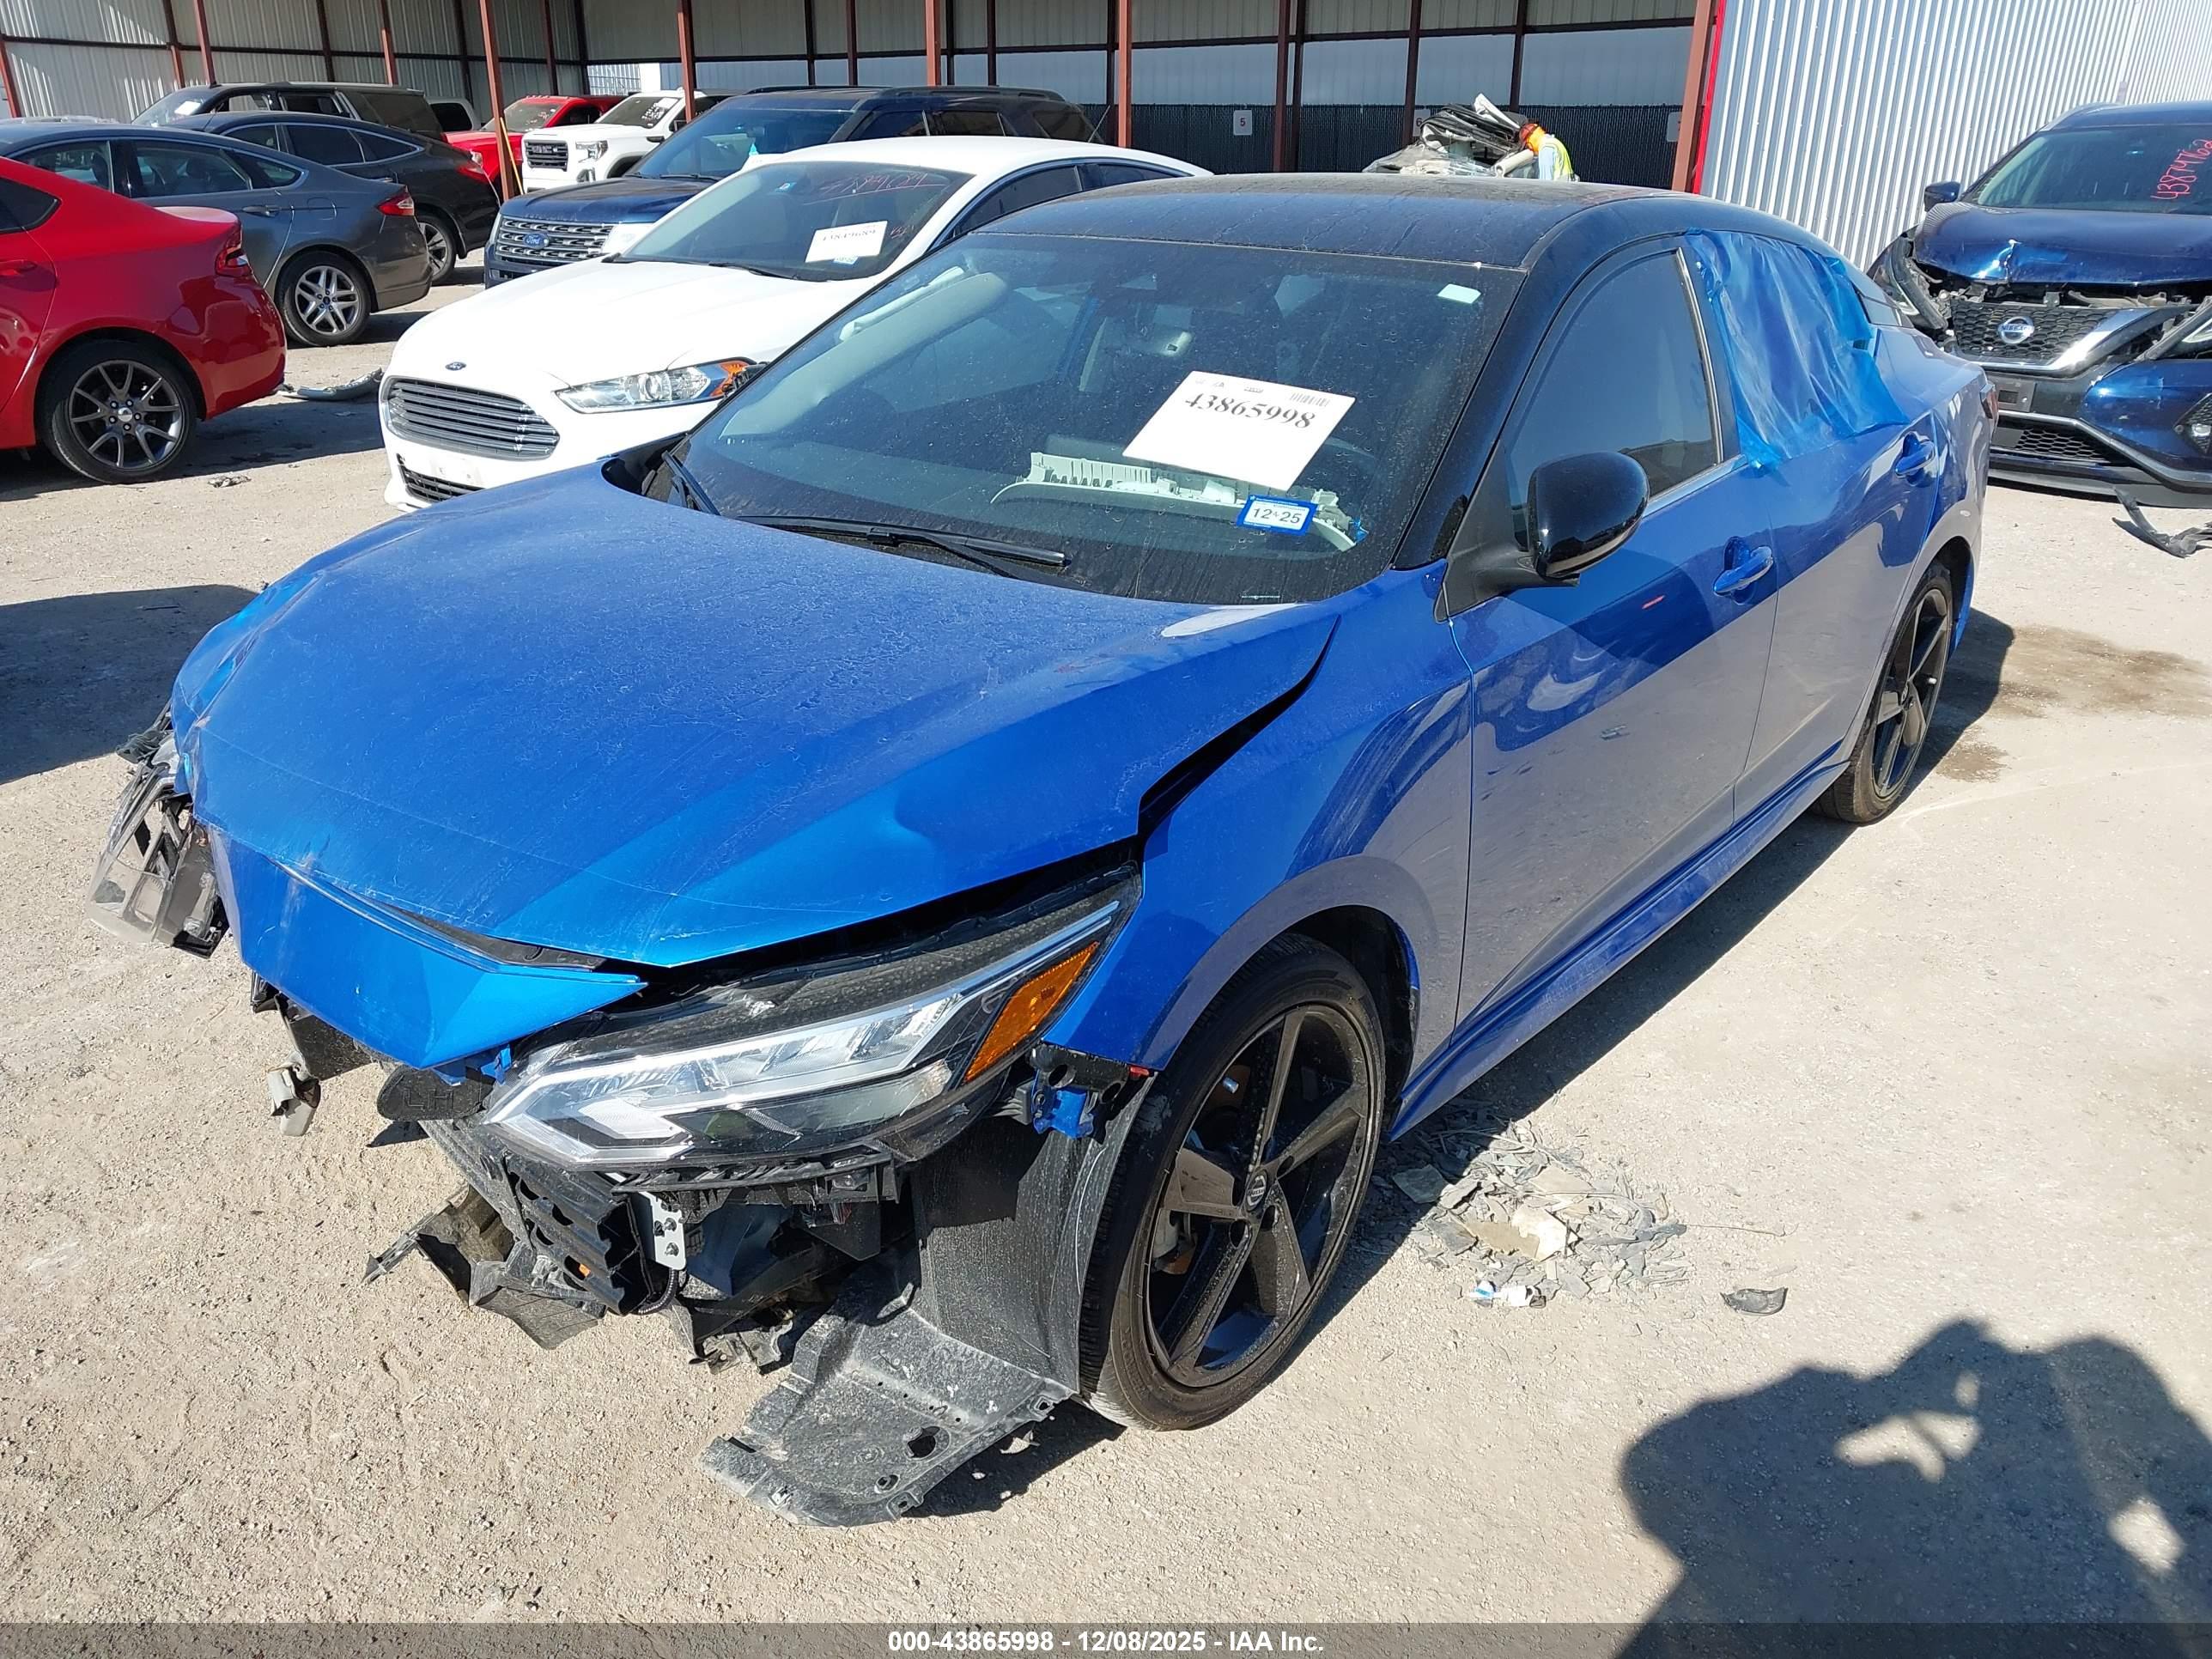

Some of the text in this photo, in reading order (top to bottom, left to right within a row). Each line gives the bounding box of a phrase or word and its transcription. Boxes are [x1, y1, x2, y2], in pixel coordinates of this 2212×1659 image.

[1240, 117, 1246, 127] 5
[1416, 117, 1423, 127] 6
[1185, 392, 1316, 428] 43865998
